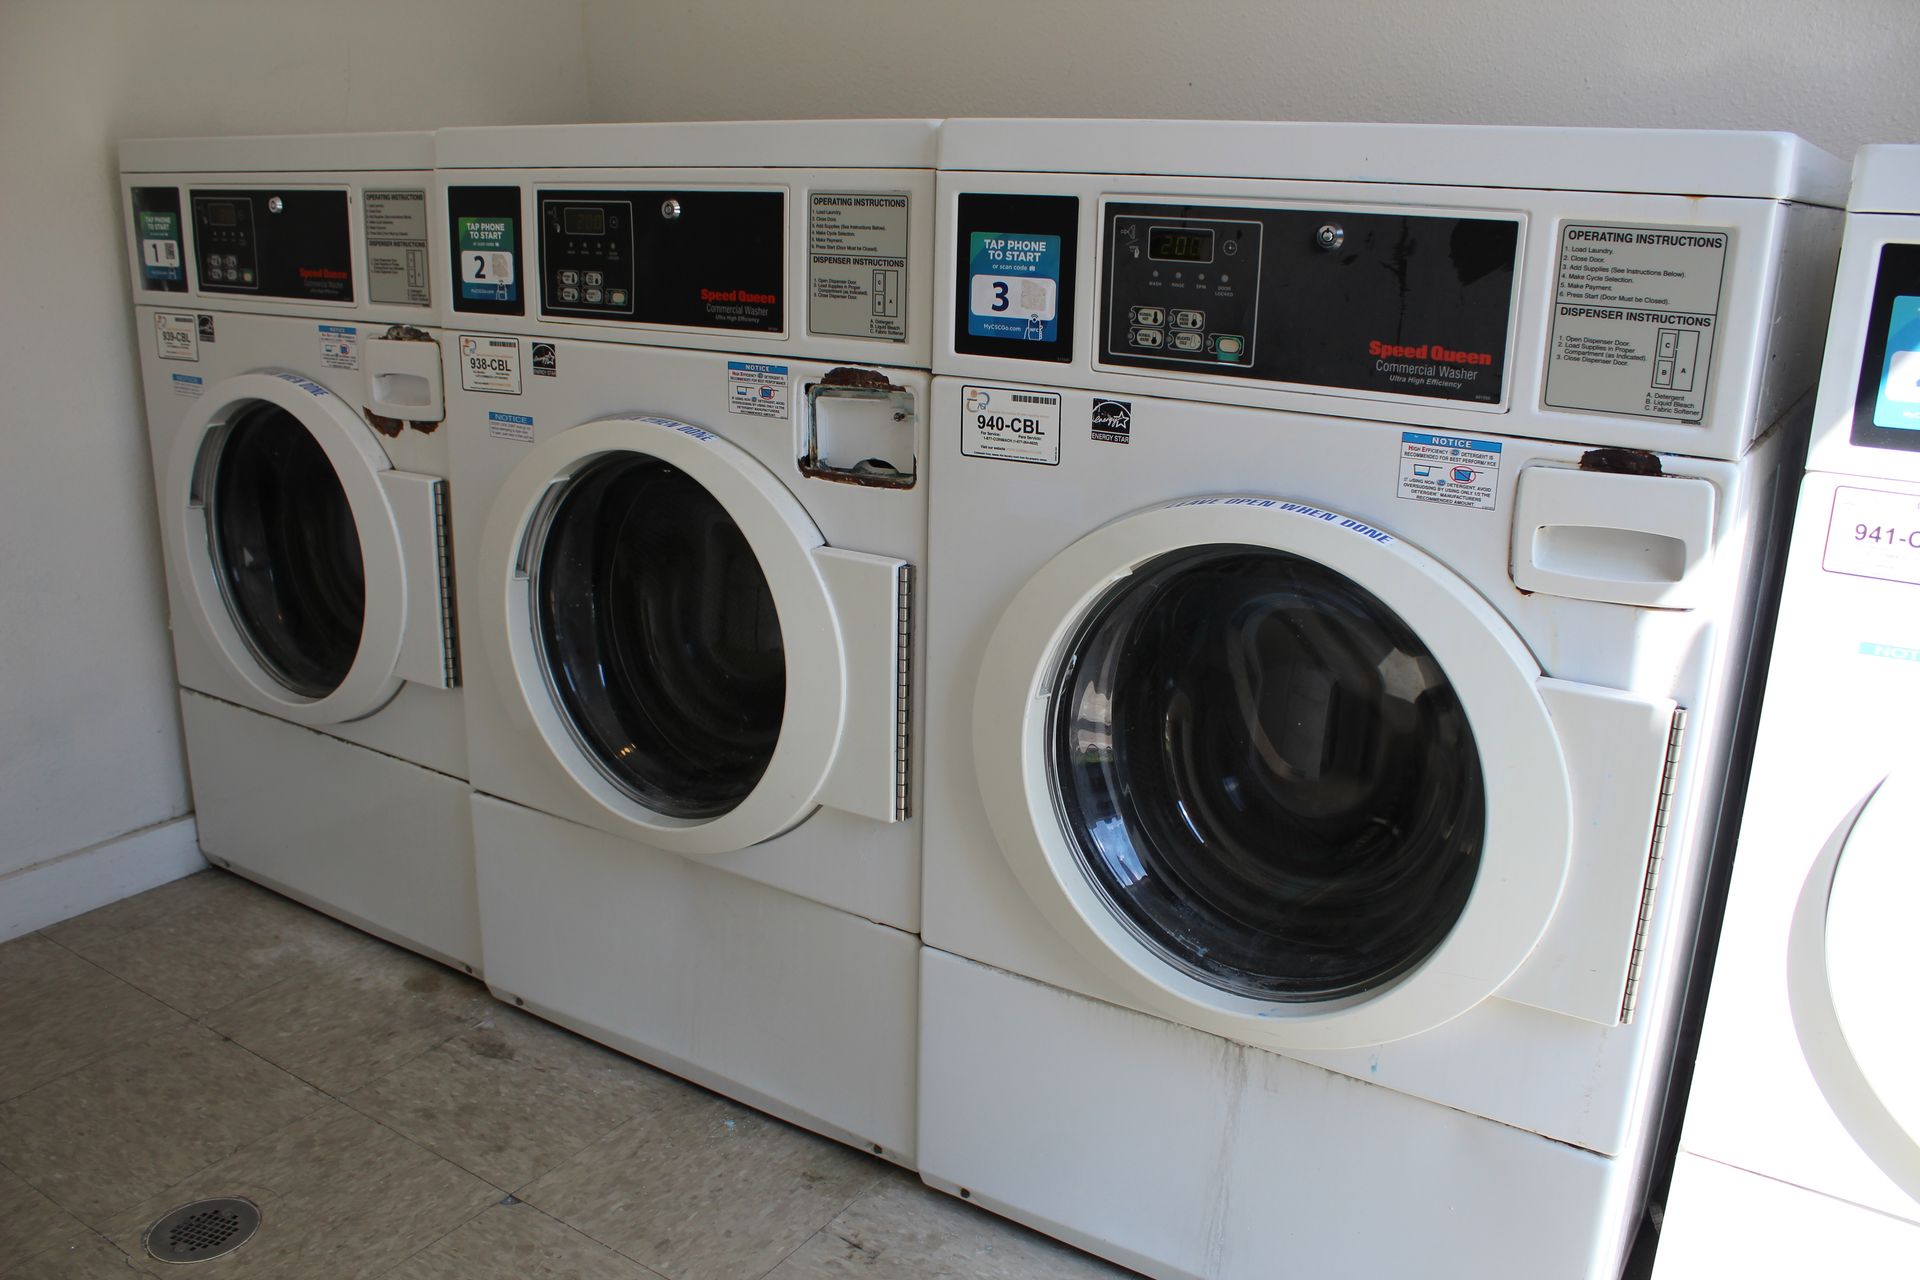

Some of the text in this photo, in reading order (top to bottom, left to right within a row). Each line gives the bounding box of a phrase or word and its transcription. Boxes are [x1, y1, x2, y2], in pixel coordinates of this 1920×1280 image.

[814, 198, 906, 207] OPERATING INSTRUCTIONS
[481, 223, 505, 231] PHONE
[1568, 230, 1722, 248] OPERATING INSTRUCTIONS
[984, 240, 1046, 251] TAP PHONE
[152, 244, 159, 262] 1
[988, 251, 1041, 262] TO START
[474, 255, 486, 279] 2
[853, 259, 904, 268] INSTRUCTIONS
[1626, 268, 1661, 276] Instructions
[1663, 270, 1685, 278] Below).
[701, 288, 776, 304] Speed Queen
[992, 281, 1009, 311] 3
[1644, 297, 1669, 305] Closed).
[706, 303, 768, 316] Commercial Washer
[738, 316, 760, 324] Efficiency
[1560, 308, 1711, 326] DISPENSER INSTRUCTIONS
[984, 324, 1021, 332] MyCSCGo.com
[163, 331, 191, 342] 939-CBL
[1583, 337, 1613, 345] Dispenser
[1369, 340, 1492, 365] Speed Queen
[1564, 348, 1604, 358] Compartment
[1581, 343, 1606, 351] Supplies
[1615, 345, 1635, 354] Proper
[471, 358, 512, 372] 938-CBL
[1582, 356, 1611, 364] Dispenser
[745, 364, 769, 372] NOTICE
[1376, 360, 1478, 380] Commercial Washer
[1408, 377, 1425, 385] High
[1426, 379, 1462, 389] Efficiency
[1654, 393, 1684, 401] Detergent
[1673, 407, 1700, 415] Softener
[495, 414, 527, 423] NOTICE
[977, 415, 1045, 435] 940-CBL
[1092, 432, 1129, 443] ENERGY STAR
[1432, 437, 1472, 448] NOTICE
[1404, 452, 1438, 460] RECOMMENDED
[1403, 483, 1436, 491] OVERSUDSING
[1416, 495, 1453, 504] RECOMMENDED
[1225, 498, 1276, 507] OPEN
[1280, 503, 1337, 521] WHEN
[1340, 519, 1394, 544] DONE
[1854, 524, 1920, 548] 941-C
